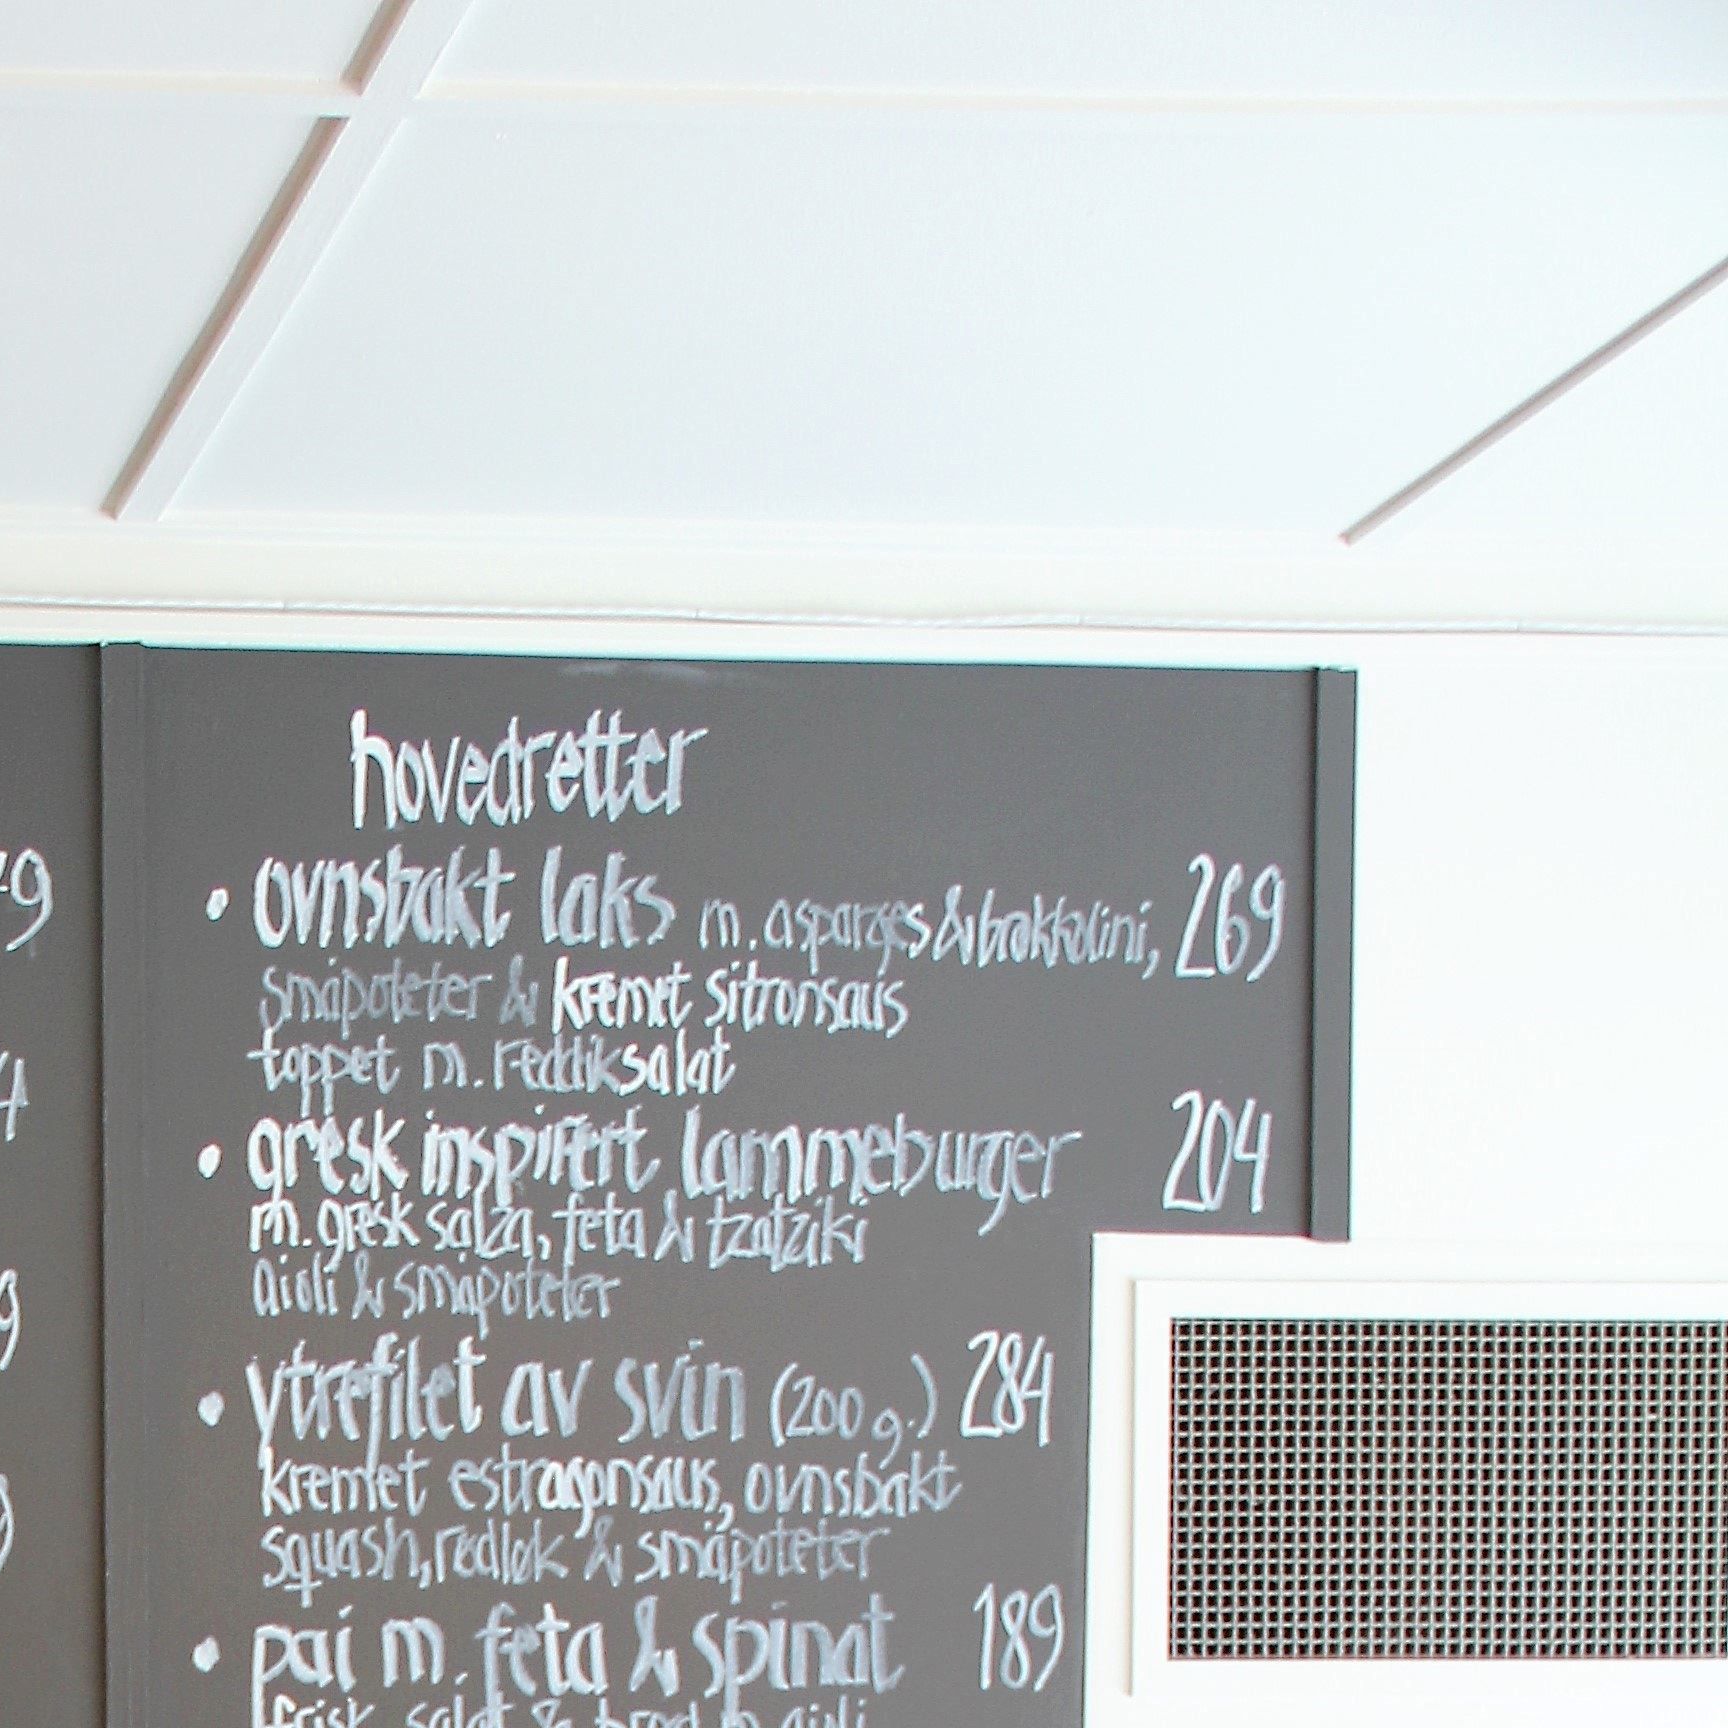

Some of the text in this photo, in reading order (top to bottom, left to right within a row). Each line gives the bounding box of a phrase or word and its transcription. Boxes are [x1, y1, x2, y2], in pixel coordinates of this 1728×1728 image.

[351, 708, 709, 830] hovedretter
[254, 844, 517, 949] ovnsbakt
[540, 846, 676, 949] laks
[1175, 853, 1285, 983] 269
[498, 953, 538, 1026] &
[248, 1026, 400, 1117] toppet
[247, 1108, 409, 1205] gresk
[681, 1104, 1082, 1236] lammeburger
[1162, 1090, 1270, 1213] 204
[655, 1189, 693, 1258] &
[253, 1253, 338, 1320] aioli
[353, 1251, 385, 1320] &
[501, 1360, 593, 1440] av
[615, 1338, 745, 1443] svin
[960, 1330, 1053, 1447] 284
[583, 1516, 622, 1574] &
[475, 1600, 608, 1710] feta
[629, 1594, 680, 1697] &
[691, 1593, 905, 1725] spinat
[974, 1582, 1065, 1693] 189
